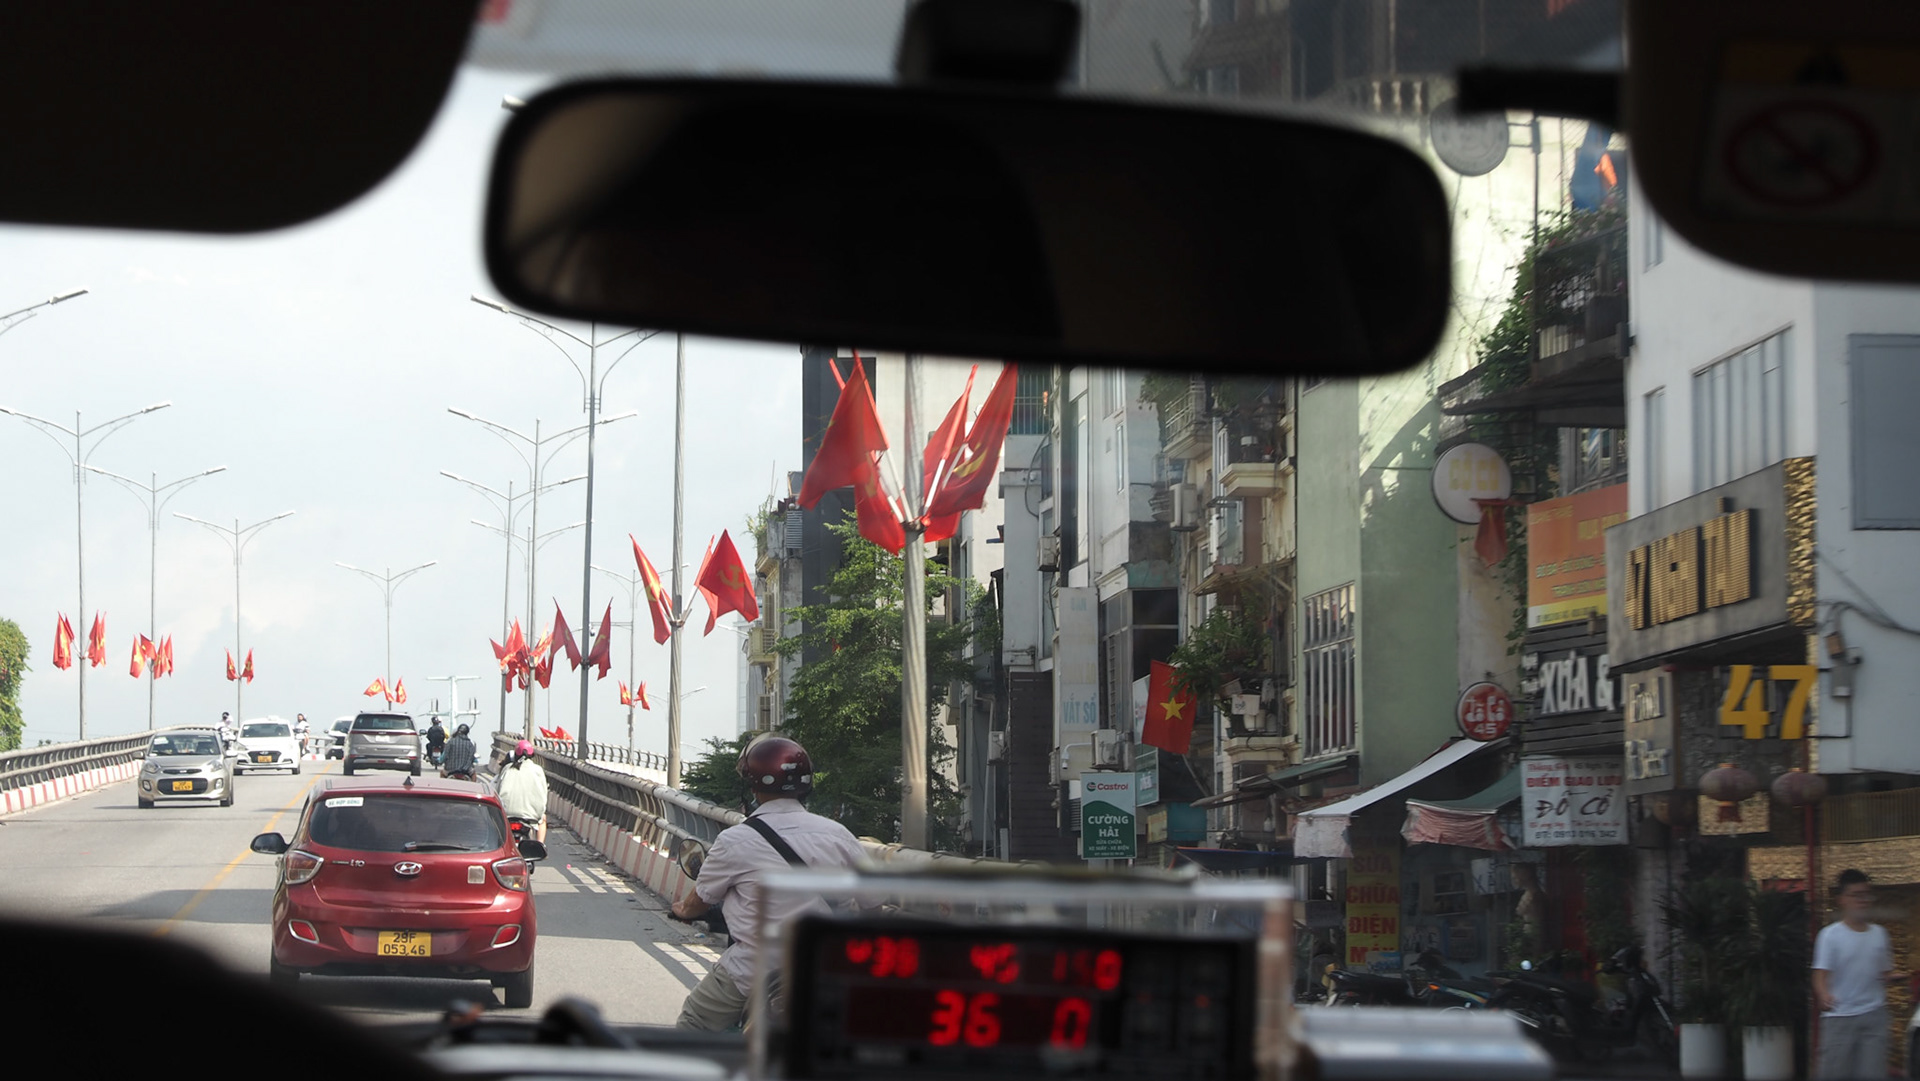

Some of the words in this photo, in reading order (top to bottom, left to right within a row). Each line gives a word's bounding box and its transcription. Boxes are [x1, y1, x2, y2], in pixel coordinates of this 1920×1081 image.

[1624, 545, 1648, 630] 47
[1719, 664, 1818, 739] 47
[1474, 723, 1497, 734] 45
[1097, 783, 1129, 791] Castrol
[1088, 813, 1129, 825] CƯỜNG
[1353, 853, 1393, 873] SỬA
[1346, 882, 1399, 904] CHỮA
[1349, 913, 1396, 938] ĐIỆN
[394, 932, 417, 943] 29F
[928, 990, 1001, 1047] 36
